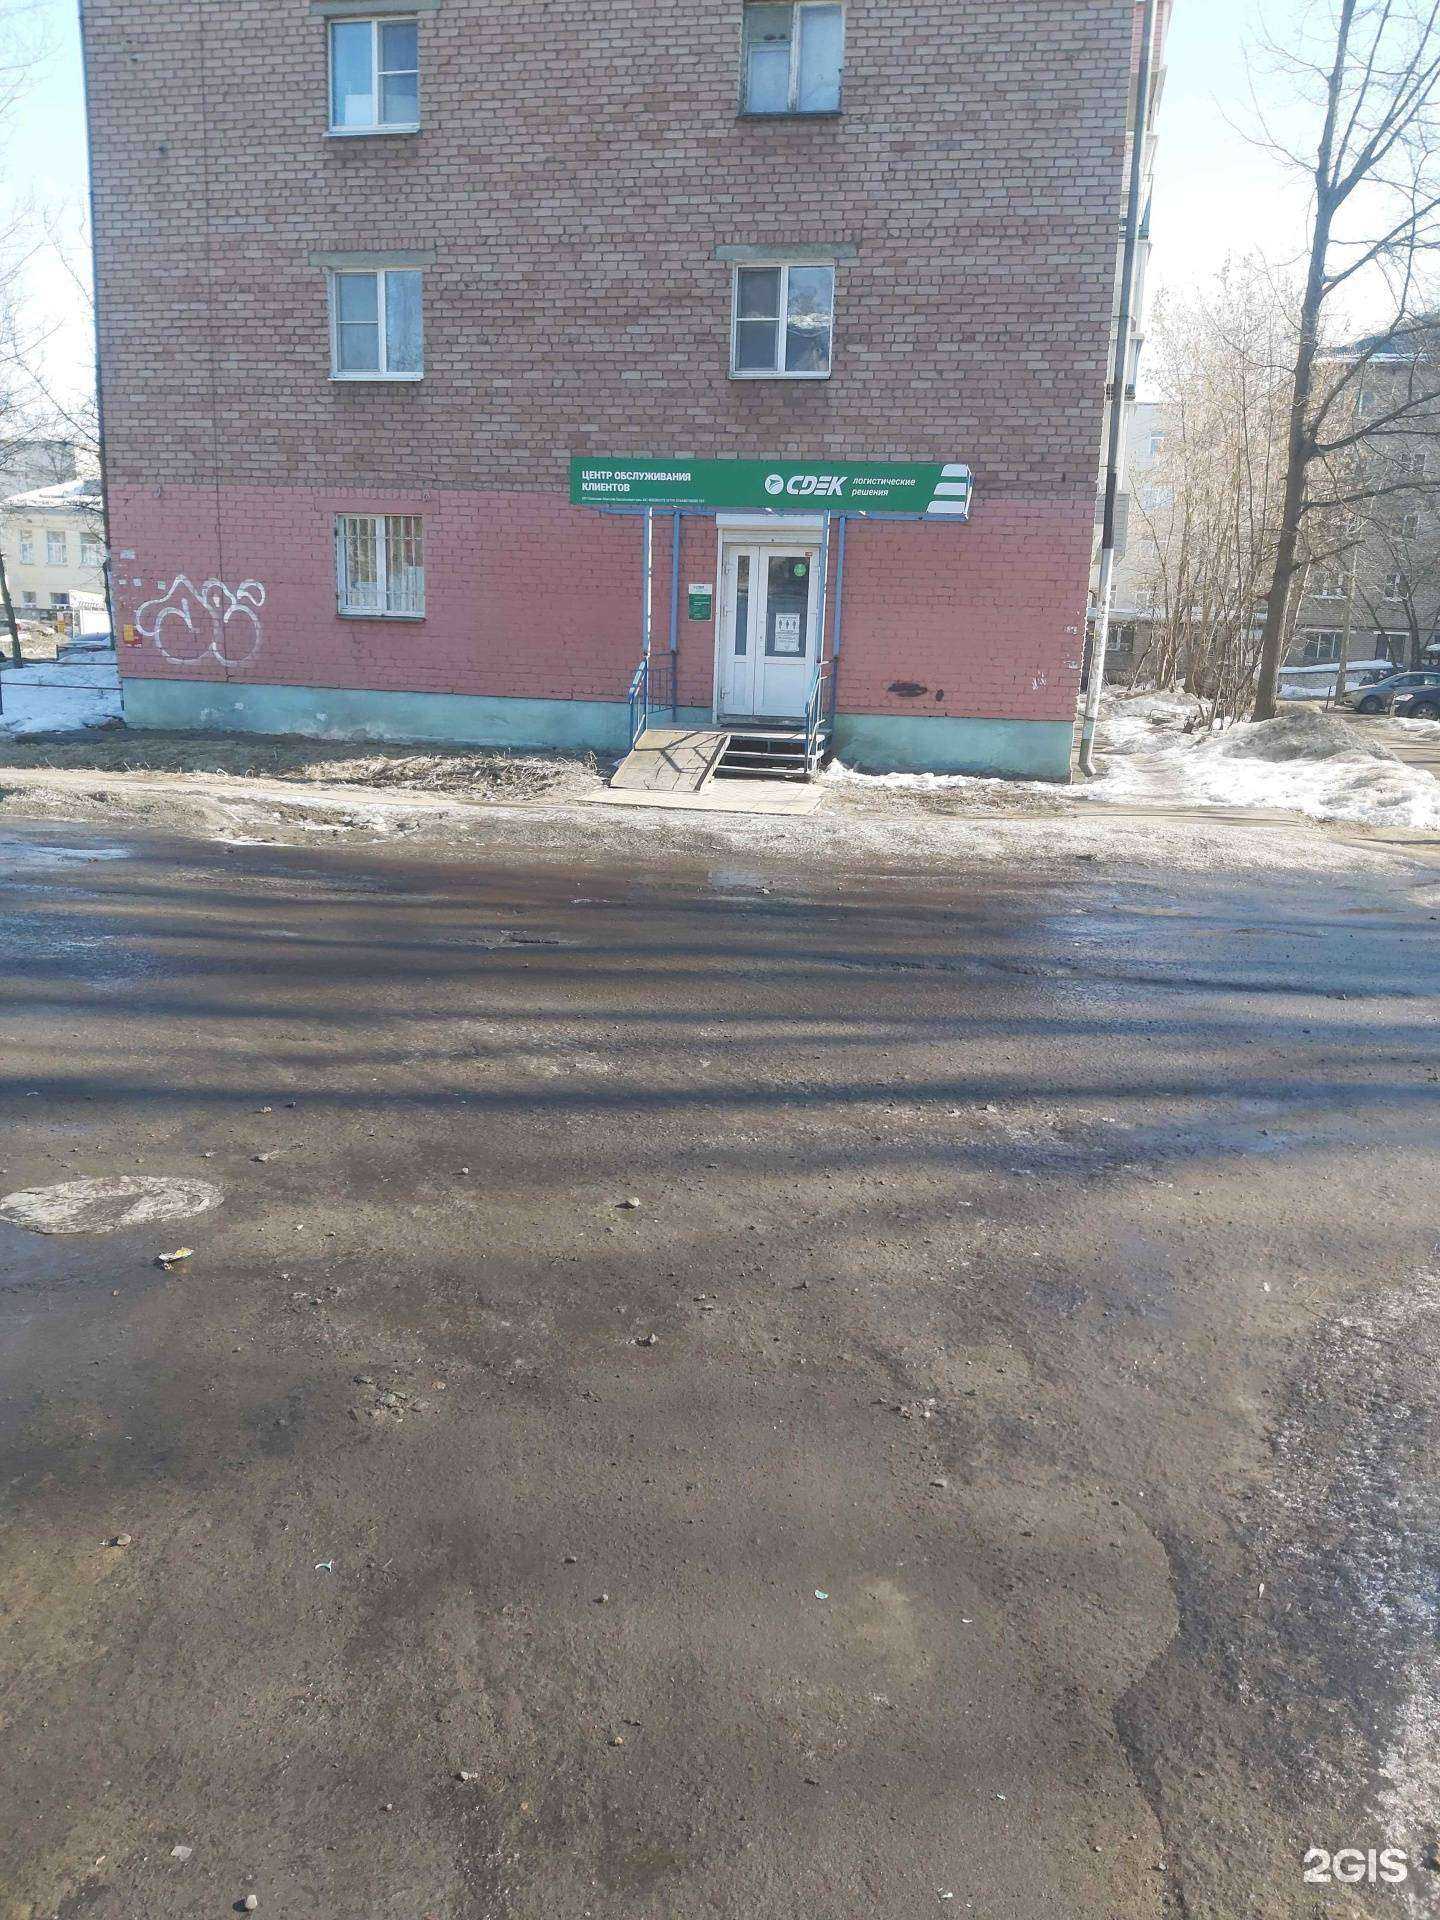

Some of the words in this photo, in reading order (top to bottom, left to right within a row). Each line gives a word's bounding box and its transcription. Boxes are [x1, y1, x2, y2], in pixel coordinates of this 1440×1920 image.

[582, 470, 612, 480] ЦЕНТР
[614, 471, 691, 481] ОБСЛУЖИВАНИЯ
[786, 475, 847, 495] CDEK
[852, 477, 916, 486] логистические
[582, 482, 630, 492] КЛИЕНТОВ
[851, 488, 889, 497] решения
